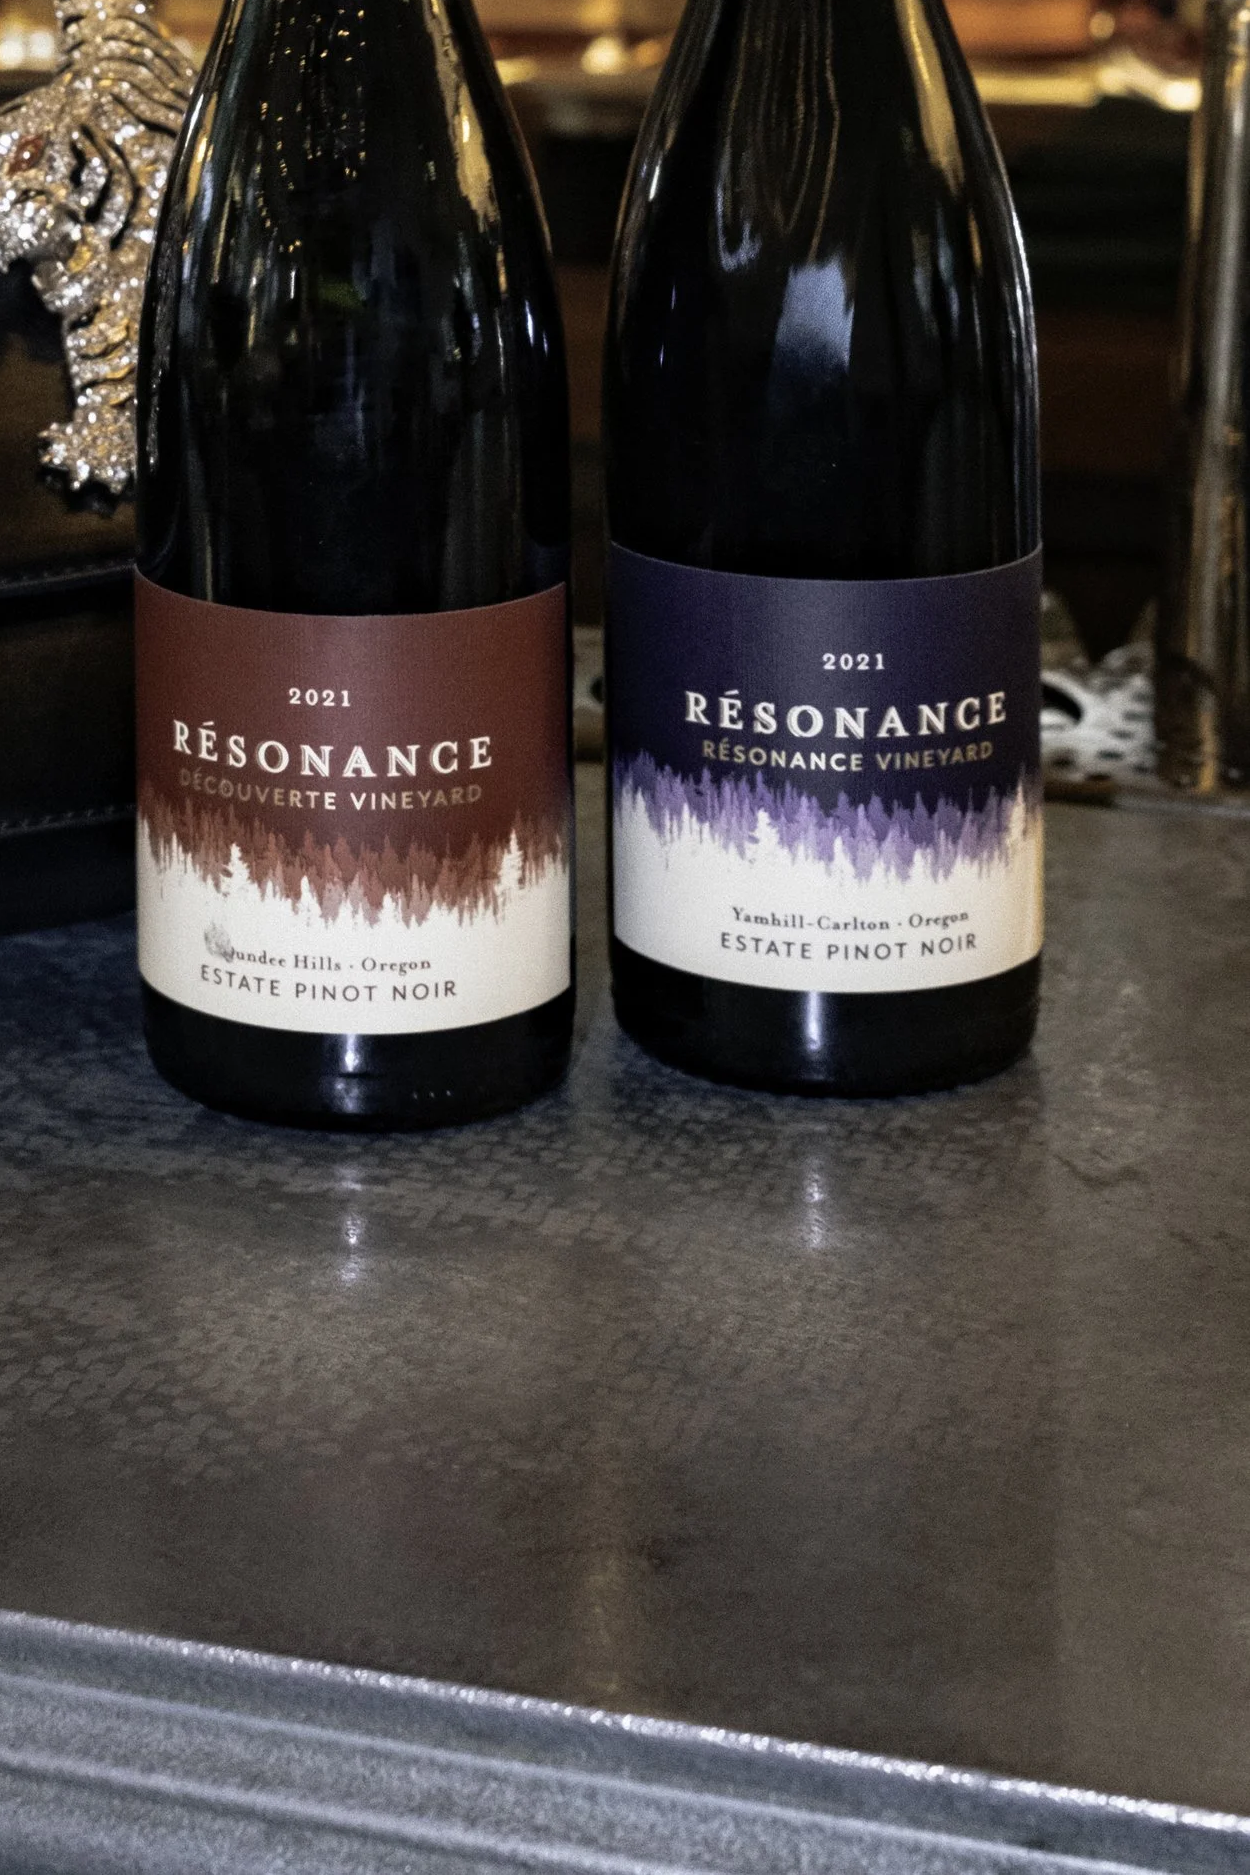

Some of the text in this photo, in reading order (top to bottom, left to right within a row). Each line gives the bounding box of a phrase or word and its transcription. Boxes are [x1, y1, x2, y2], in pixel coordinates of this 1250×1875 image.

[822, 652, 886, 671] 2021
[288, 687, 351, 707] 2021
[684, 689, 1007, 739] RÉSONANCE
[173, 719, 493, 778] RÉSONANCE
[701, 737, 994, 772] RÉSONANCE VINEYARD
[179, 766, 483, 811] DÉCOUVERTE VINEYARD
[732, 906, 969, 932] Yamhill-Carlton Oregon
[721, 931, 977, 962] ESTATE PINOT NOIR
[293, 954, 342, 972] Hills
[361, 956, 432, 976] Oregon
[201, 965, 457, 1003] ESTATE PINOT NOIR
